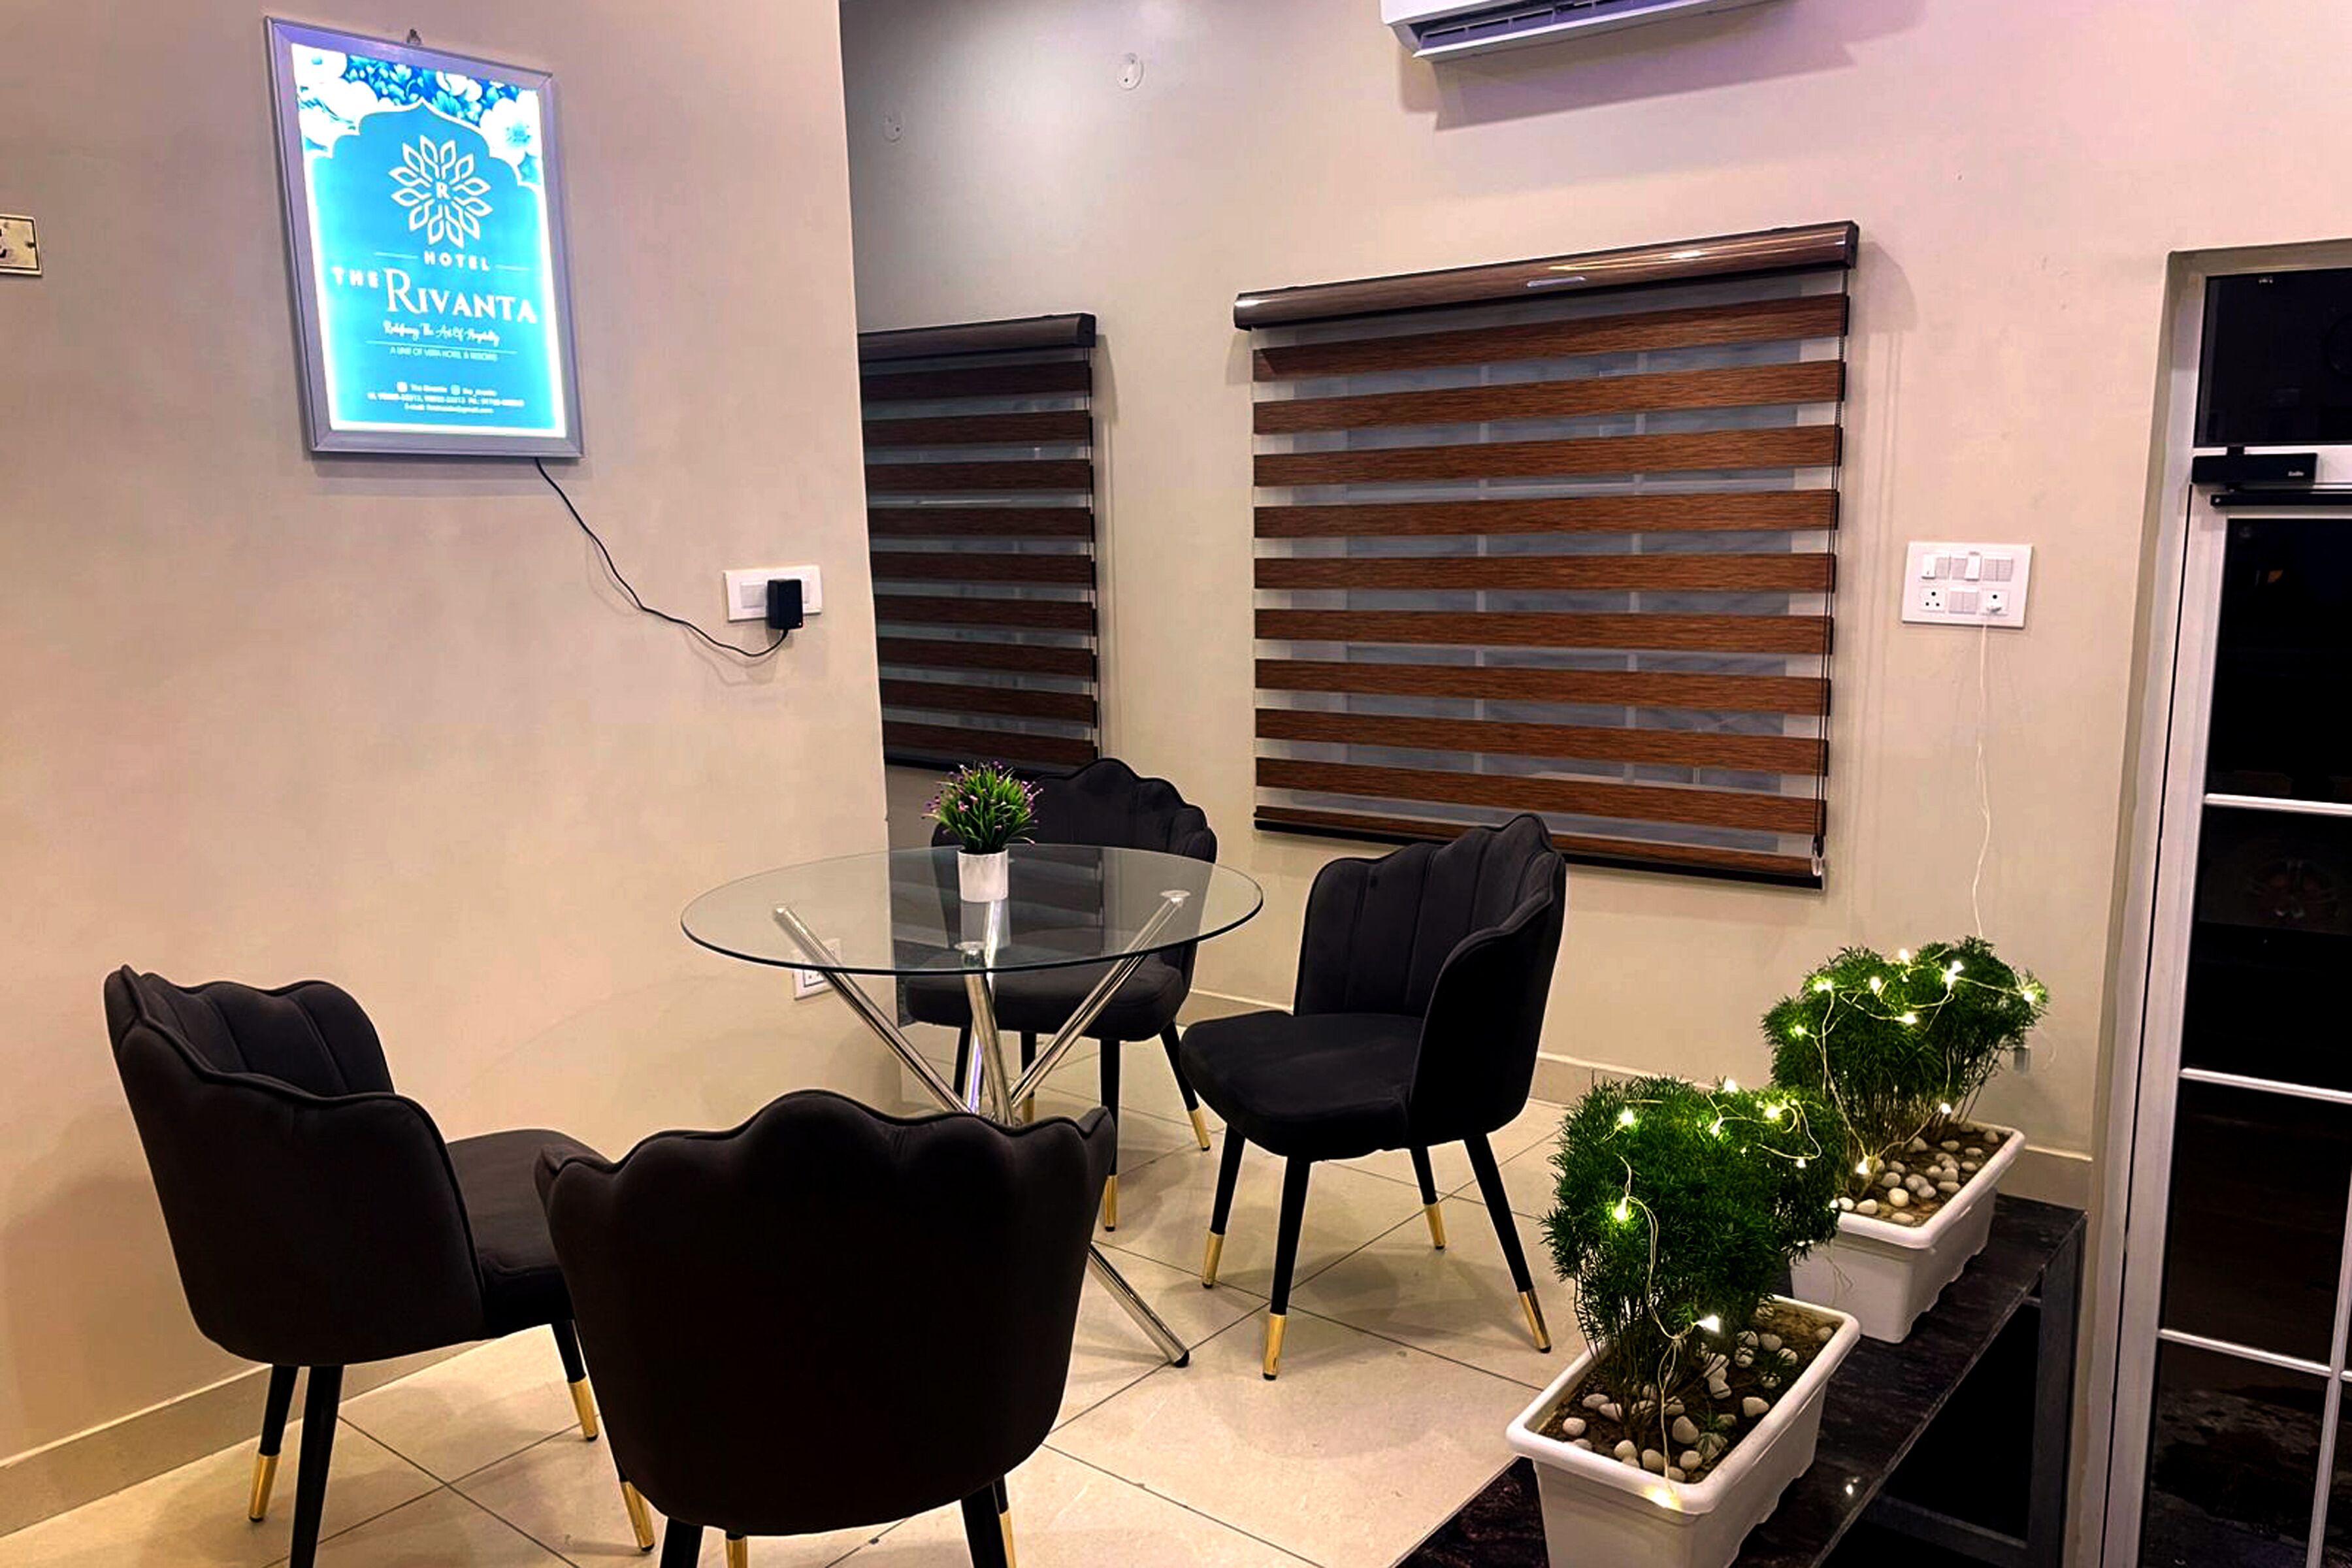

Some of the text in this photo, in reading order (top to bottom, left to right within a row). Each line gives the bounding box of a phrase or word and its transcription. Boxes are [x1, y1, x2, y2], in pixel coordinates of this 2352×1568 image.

[436, 182, 450, 199] R
[425, 251, 489, 271] HOTEL
[331, 266, 538, 324] THE RIVANTA
